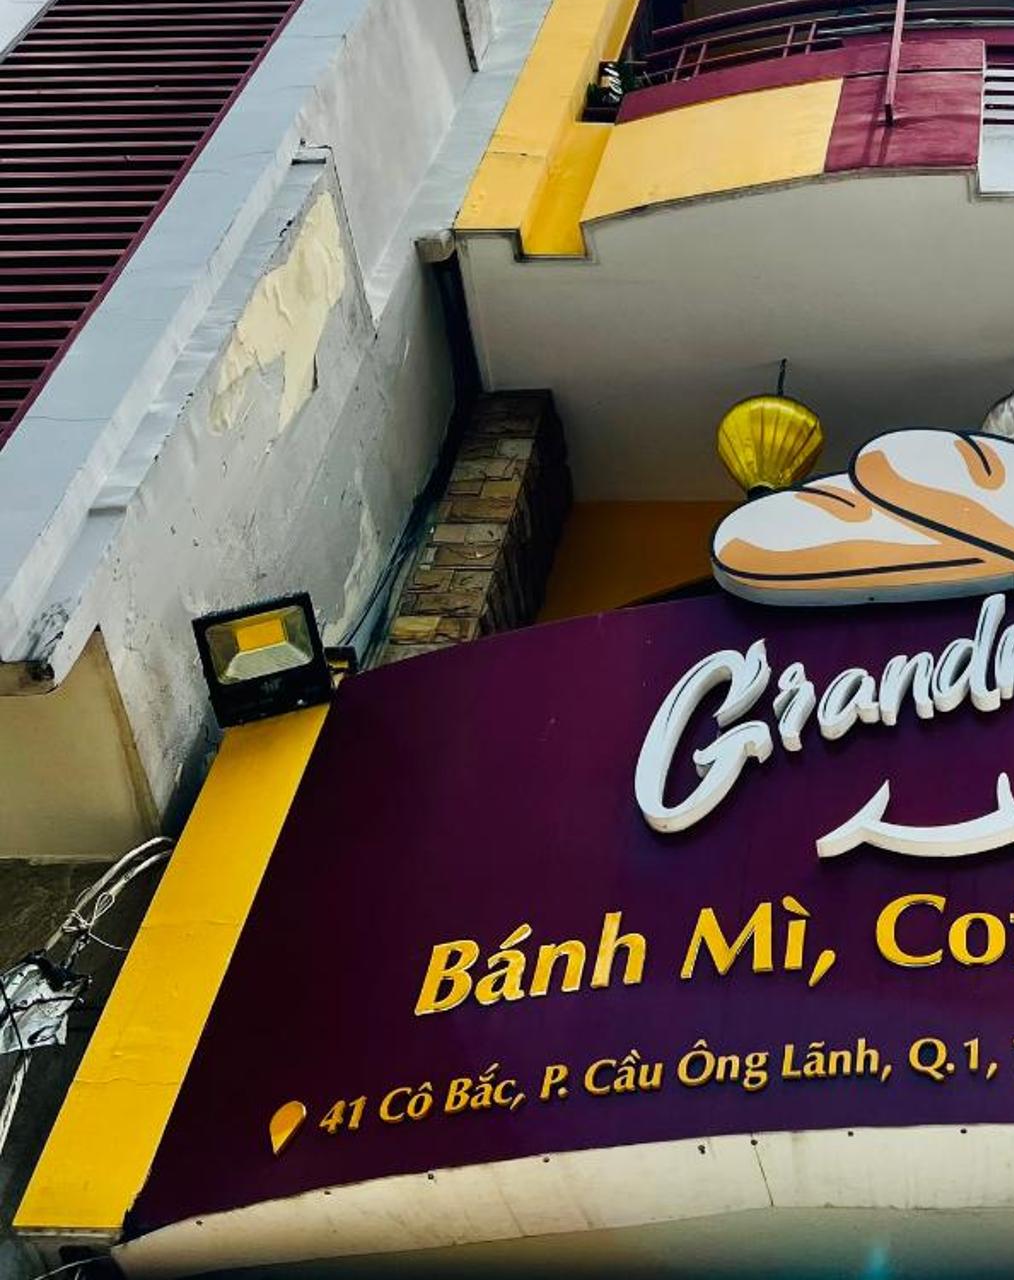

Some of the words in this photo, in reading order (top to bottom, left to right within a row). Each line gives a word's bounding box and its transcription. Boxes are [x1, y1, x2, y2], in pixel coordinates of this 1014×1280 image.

[415, 912, 646, 1016] Bánh
[681, 896, 835, 986] Mì,
[320, 1097, 366, 1132] 41
[380, 1082, 433, 1121] Cô
[445, 1063, 524, 1112] Bắc,
[541, 1065, 569, 1099] P.
[585, 1050, 663, 1094] Cầu
[678, 1040, 769, 1090] Ông
[782, 1038, 892, 1081] Lãnh,
